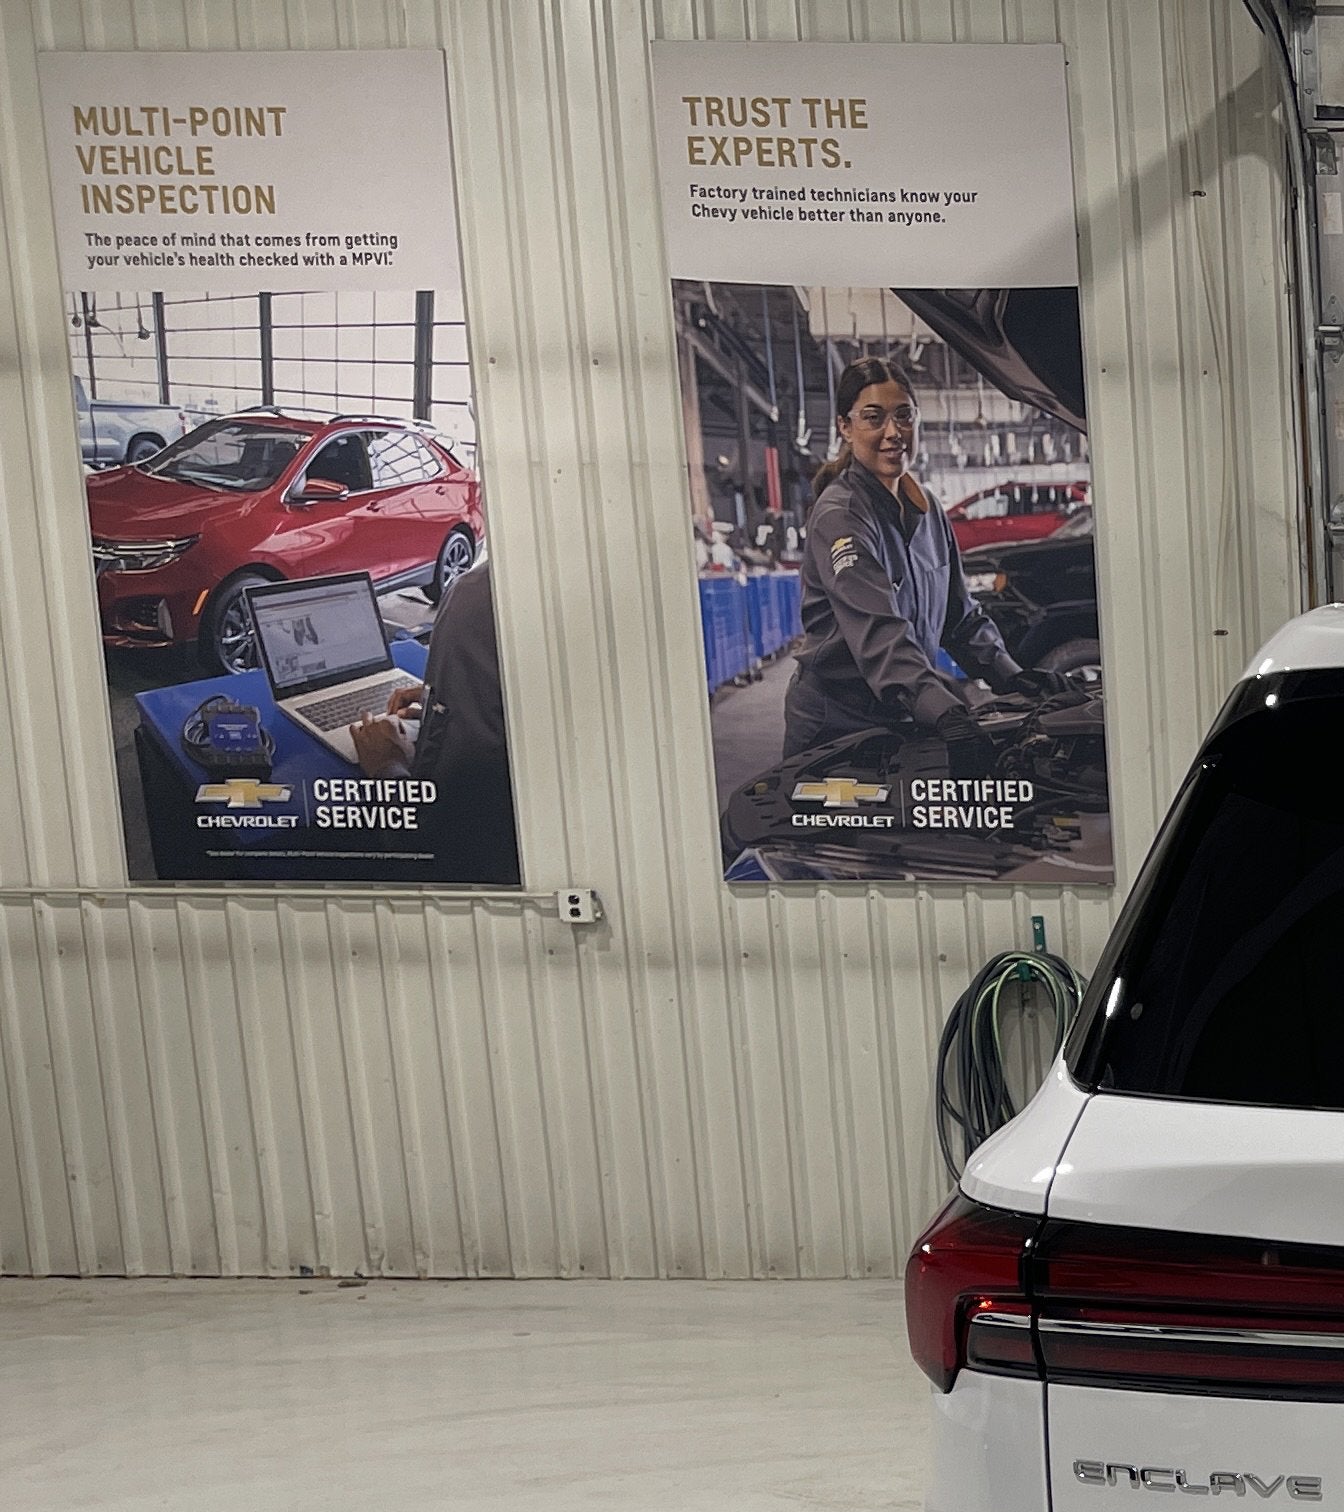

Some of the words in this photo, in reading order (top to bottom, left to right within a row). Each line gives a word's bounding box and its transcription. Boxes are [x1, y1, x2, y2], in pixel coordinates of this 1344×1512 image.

[72, 105, 287, 137] MULTI-POINT
[681, 96, 792, 128] TRUST
[801, 97, 869, 130] THE
[75, 145, 215, 176] VEHICLE
[687, 135, 852, 169] EXPERTS.
[80, 184, 276, 215] INSPECTION
[689, 184, 748, 202] Factory
[752, 186, 806, 201] trained
[810, 187, 896, 203] technicians
[900, 188, 940, 203] know
[944, 190, 978, 206] your
[691, 204, 738, 221] Chevy
[741, 206, 794, 221] vehicle
[798, 207, 846, 222] better
[849, 208, 883, 223] than
[888, 210, 946, 226] anyone.
[85, 233, 112, 247] The
[116, 235, 158, 250] peace
[162, 233, 177, 247] of
[181, 233, 216, 247] mind
[220, 233, 251, 247] that
[254, 235, 301, 248] comes
[305, 233, 340, 248] from
[345, 234, 398, 250] getting
[87, 255, 119, 269] your
[123, 252, 185, 266] vehicle's
[189, 253, 235, 266] health
[239, 253, 299, 266] checked
[303, 253, 335, 266] with
[339, 256, 348, 266] a
[314, 779, 437, 804] CERTIFIED
[911, 779, 1034, 803] CERTIFIED
[196, 815, 299, 828] CHEVROLET
[316, 806, 418, 829] SERVICE
[791, 814, 895, 828] CHEVROLET
[912, 806, 1014, 829] SERVICE
[1072, 1459, 1323, 1501] ENCLAVE
